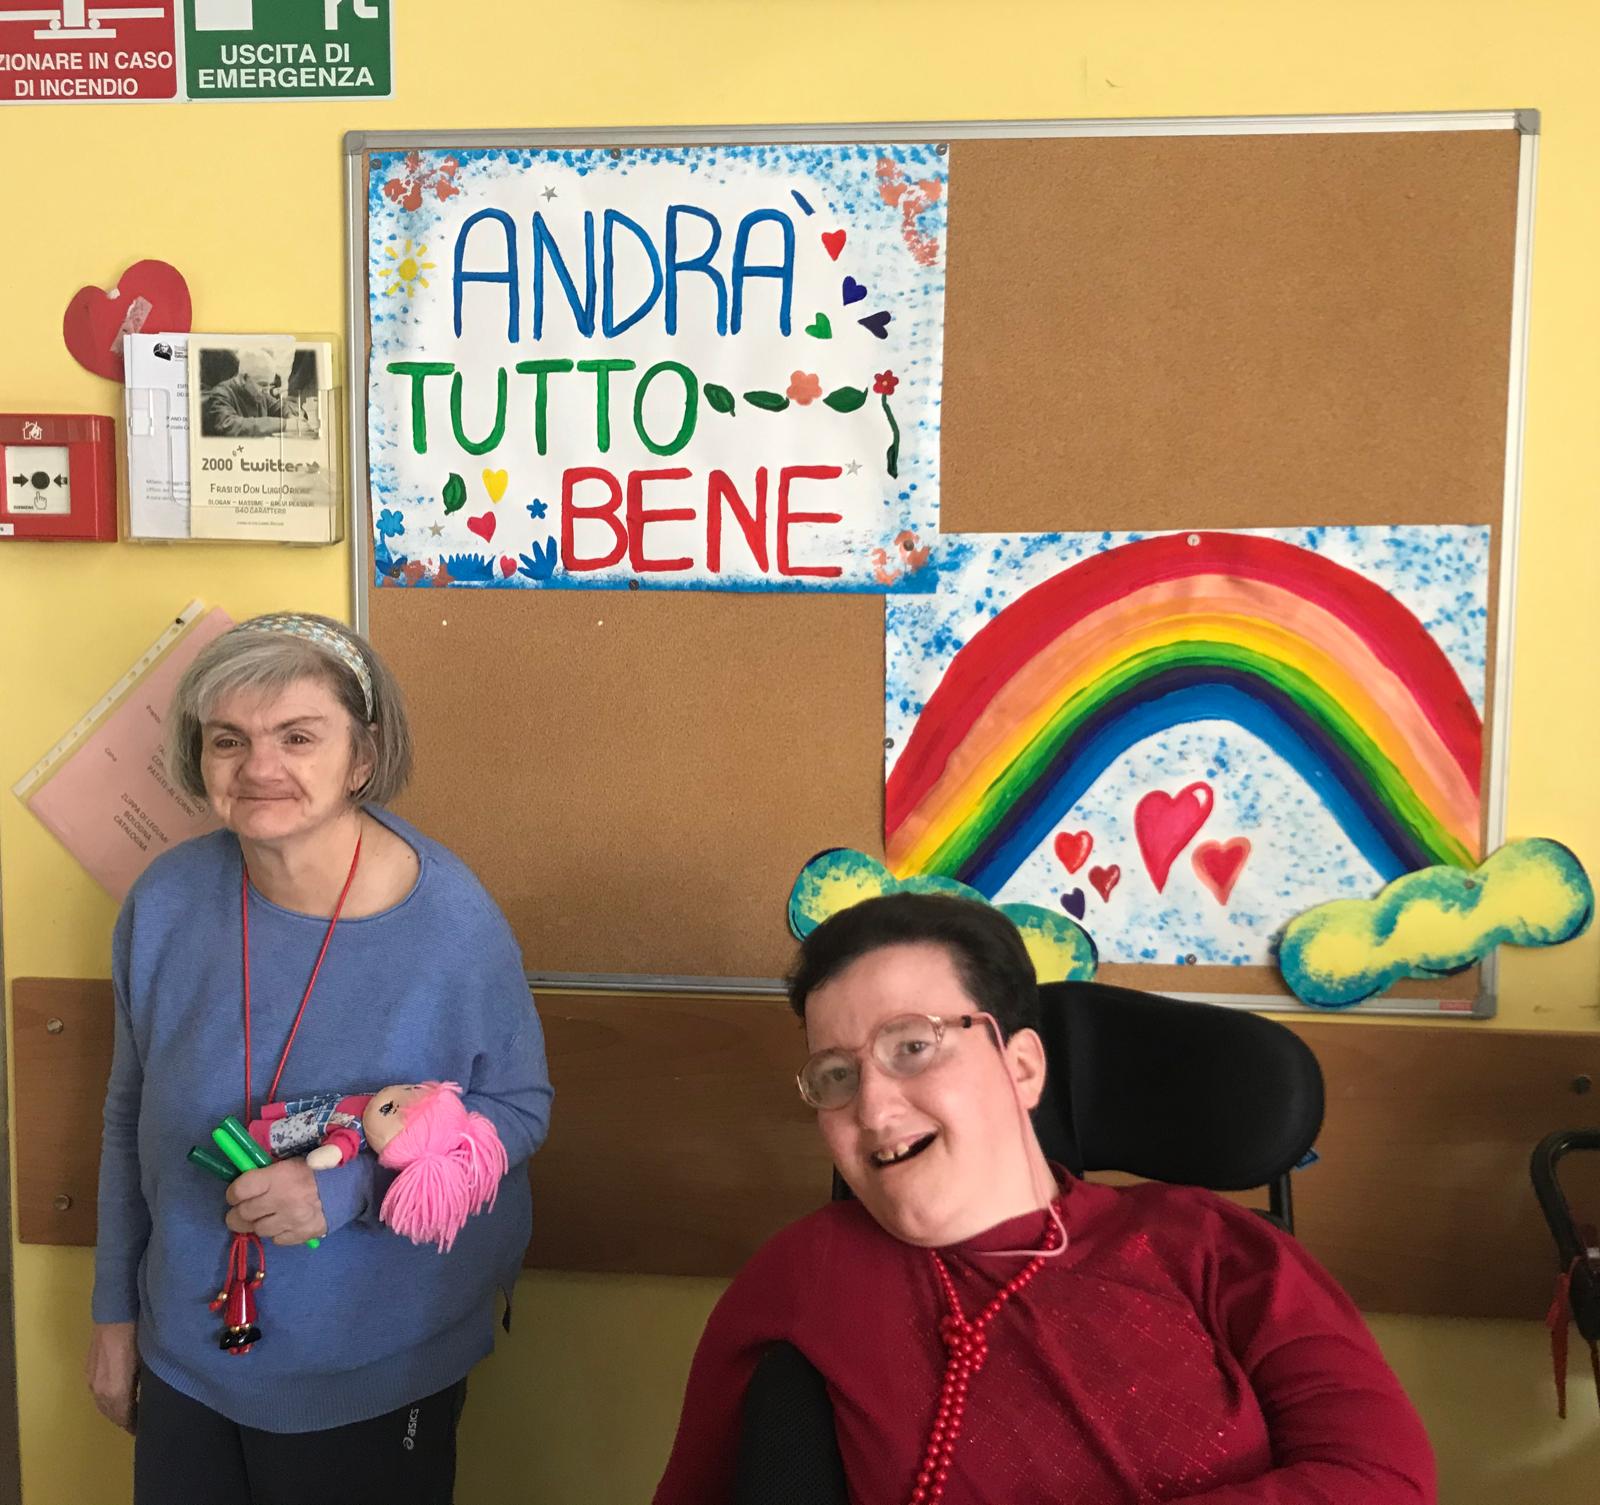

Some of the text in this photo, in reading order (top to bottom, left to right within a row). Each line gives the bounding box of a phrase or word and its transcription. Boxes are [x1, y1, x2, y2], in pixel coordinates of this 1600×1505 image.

[89, 52, 110, 70] IN
[115, 51, 173, 70] CASO
[220, 43, 350, 65] USCITA DI
[15, 78, 138, 97] DI INCENDIO
[198, 66, 375, 89] EMERGENZA
[452, 189, 815, 343] ANDRÀ
[386, 358, 699, 456] TUTTO
[201, 458, 233, 471] 2000
[240, 458, 303, 472] twitter
[561, 466, 843, 578] BENE
[407, 1408, 420, 1437] asics
